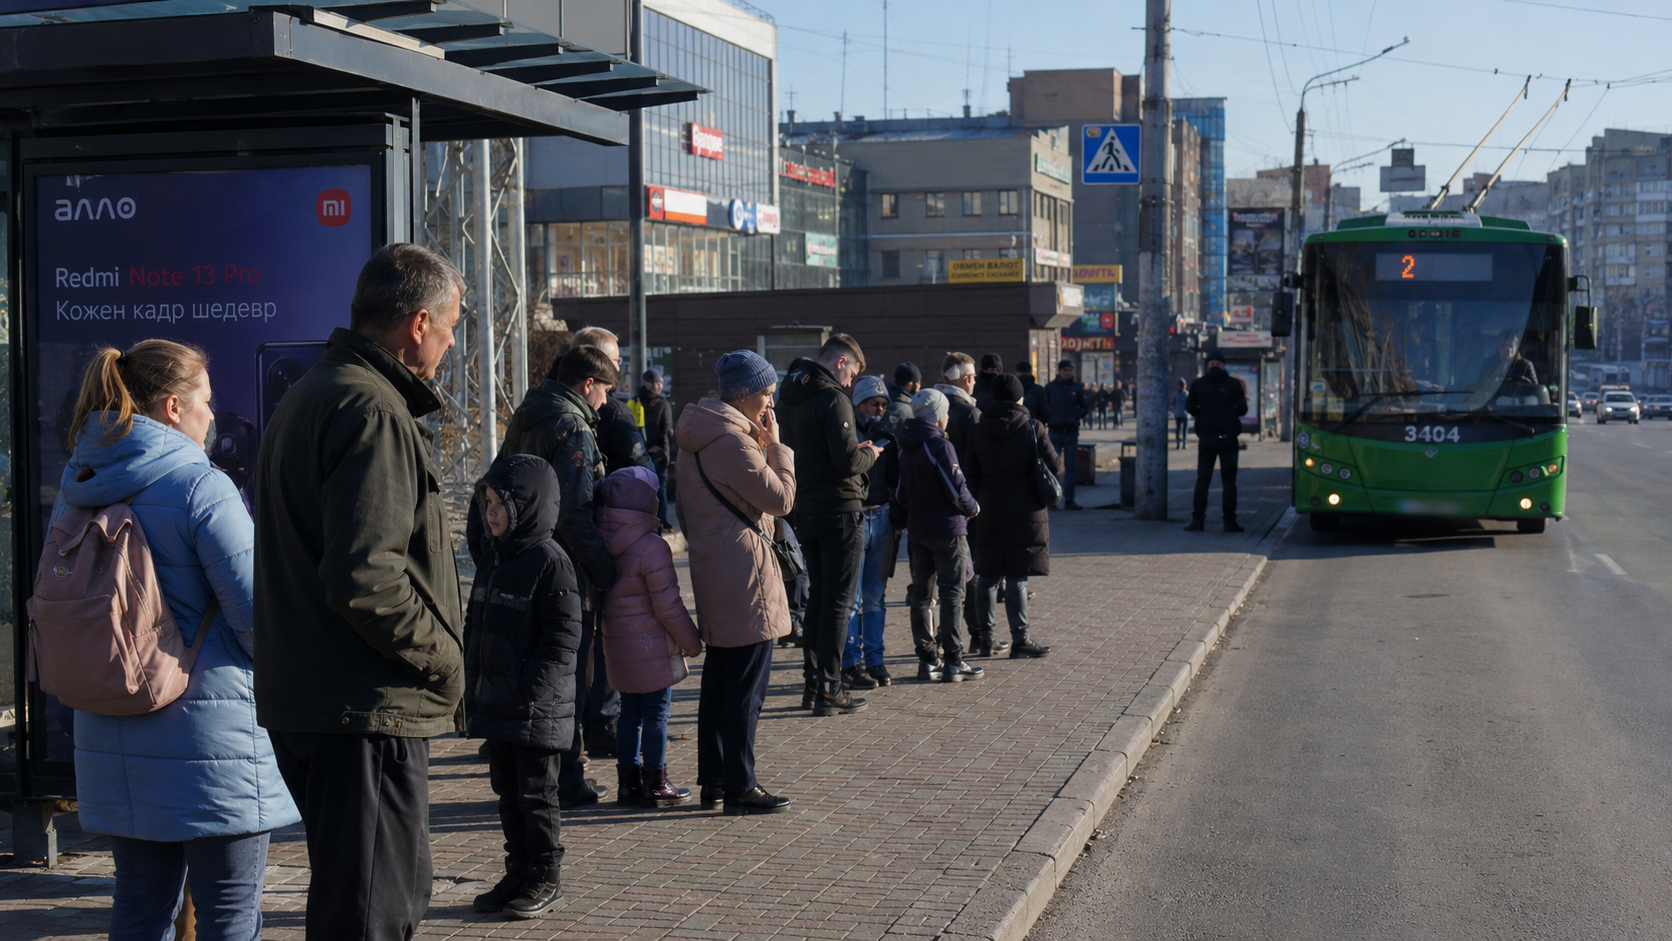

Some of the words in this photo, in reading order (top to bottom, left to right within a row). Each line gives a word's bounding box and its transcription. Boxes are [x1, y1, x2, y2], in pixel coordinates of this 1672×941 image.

[55, 266, 119, 288] Redmi
[129, 266, 184, 287] Note
[192, 265, 215, 285] 13
[224, 264, 262, 285] Pro
[1401, 255, 1415, 279] 2
[56, 299, 126, 321] Кожен
[133, 302, 185, 325] кадр
[191, 300, 278, 323] шедевр
[1404, 425, 1460, 443] 3404
